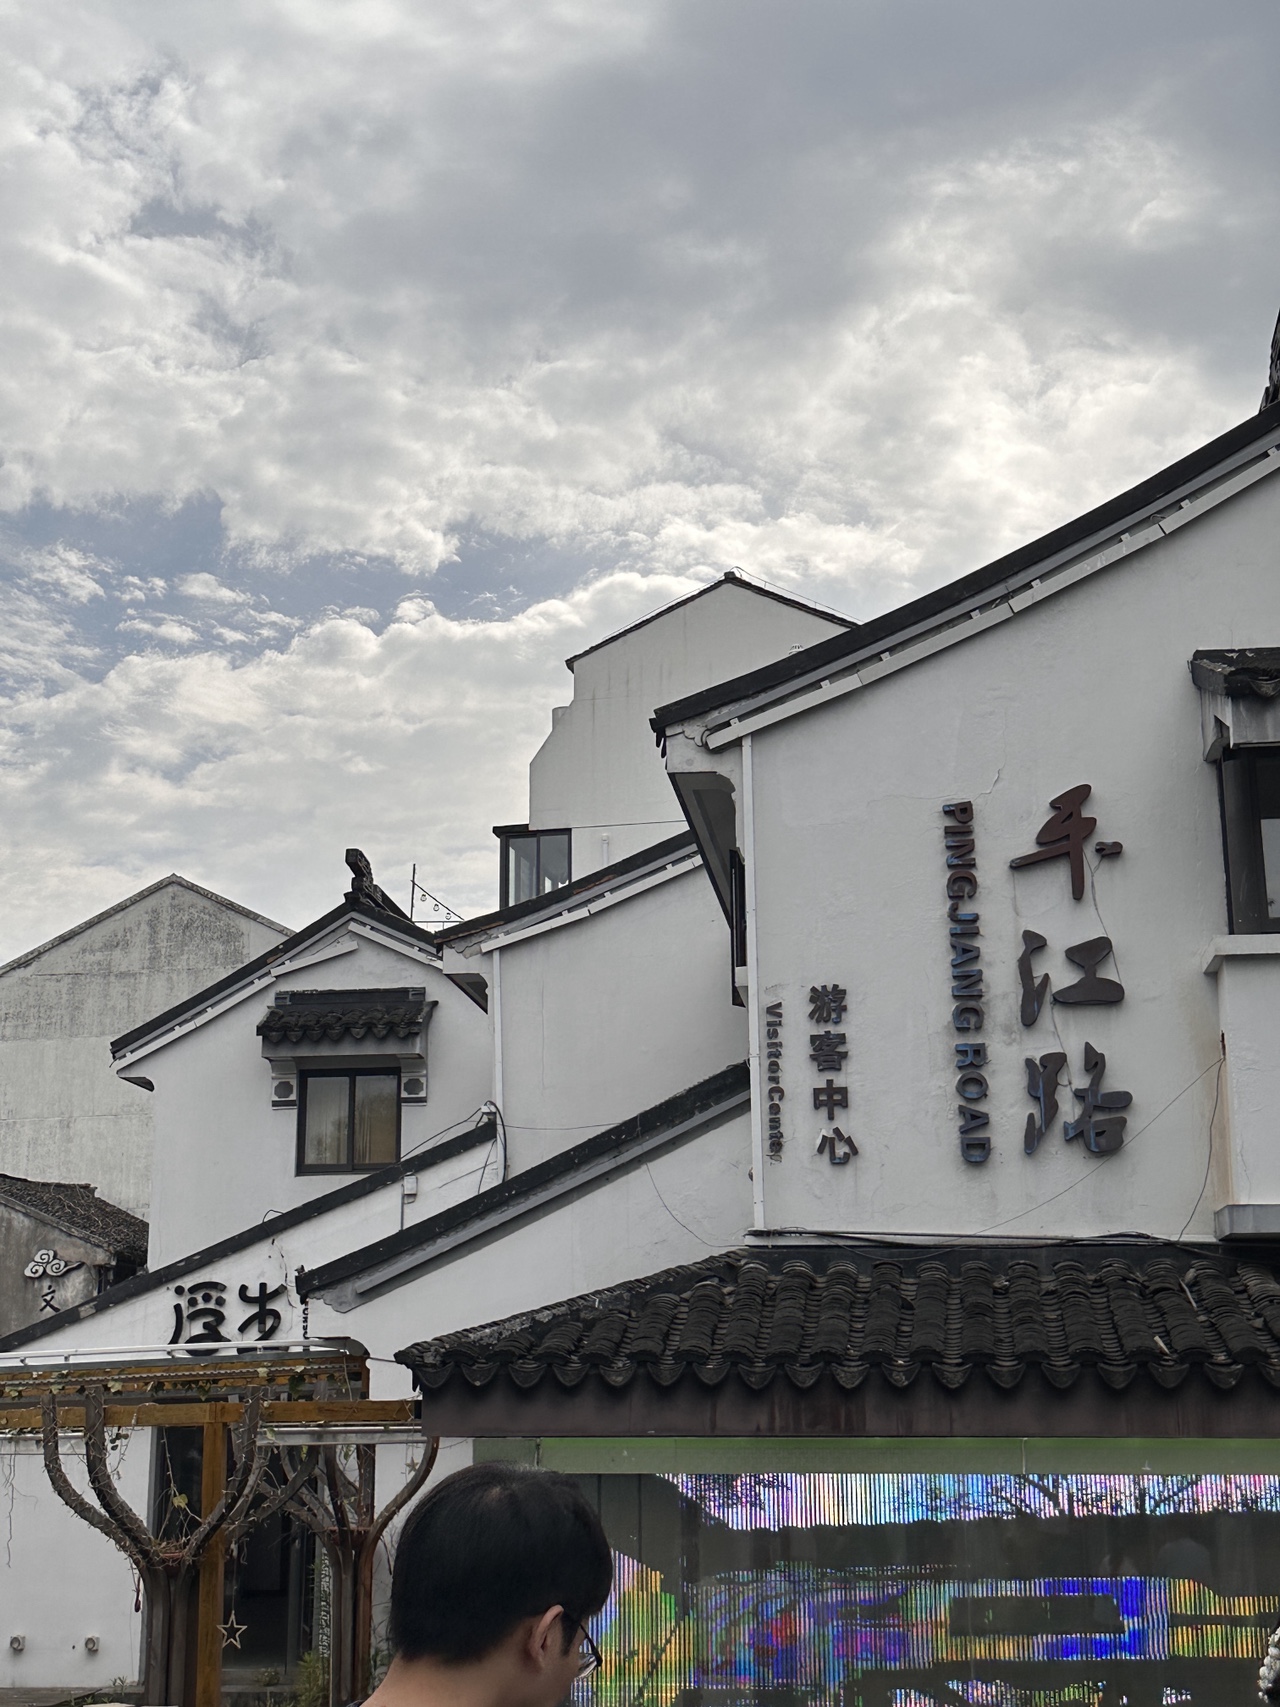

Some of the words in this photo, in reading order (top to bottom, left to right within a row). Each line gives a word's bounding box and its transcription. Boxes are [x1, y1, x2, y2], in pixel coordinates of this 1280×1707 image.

[942, 800, 985, 1031] PINGJIANG
[1009, 783, 1133, 1155] 平江路
[808, 984, 859, 1165] 游客中心
[954, 1042, 991, 1164] ROAD
